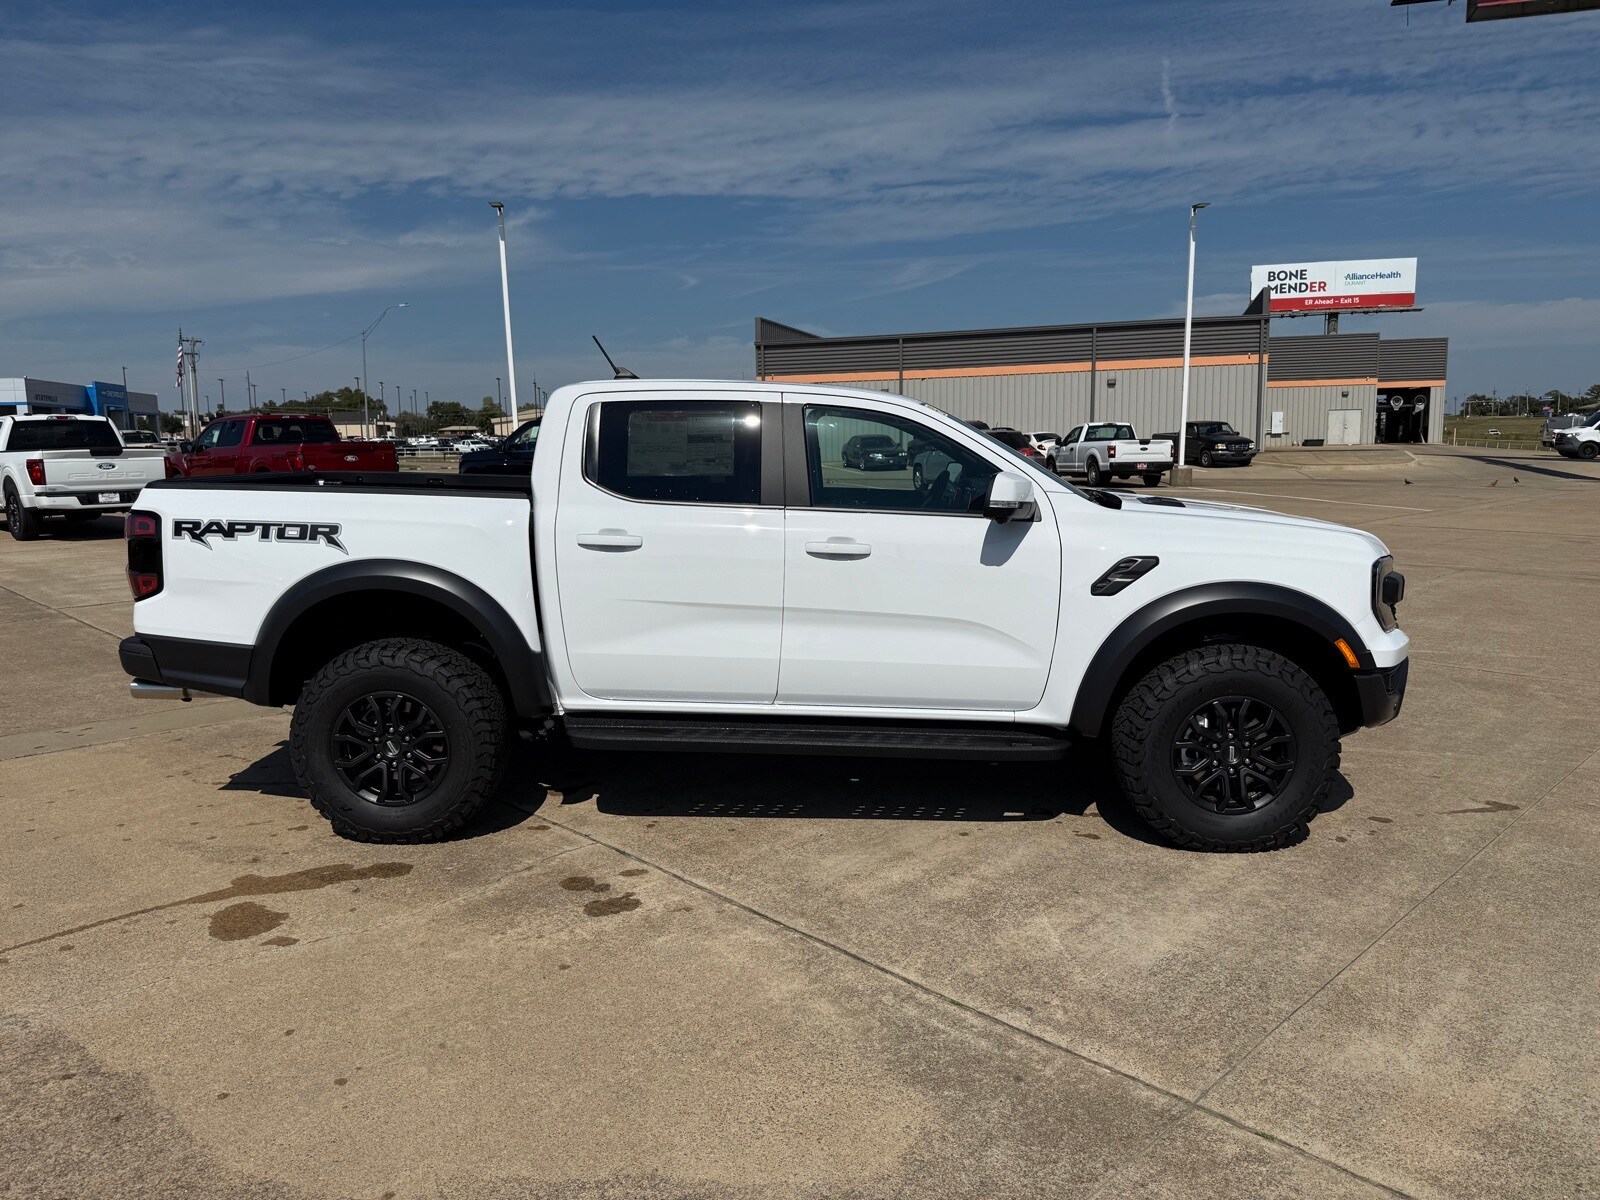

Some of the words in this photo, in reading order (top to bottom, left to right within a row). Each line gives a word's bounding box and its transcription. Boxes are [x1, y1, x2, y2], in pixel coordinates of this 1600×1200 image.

[1267, 269, 1307, 282] BONE
[1344, 271, 1402, 280] AllianceHealth
[1267, 281, 1327, 294] MENDER
[171, 518, 349, 556] RAPTOR
